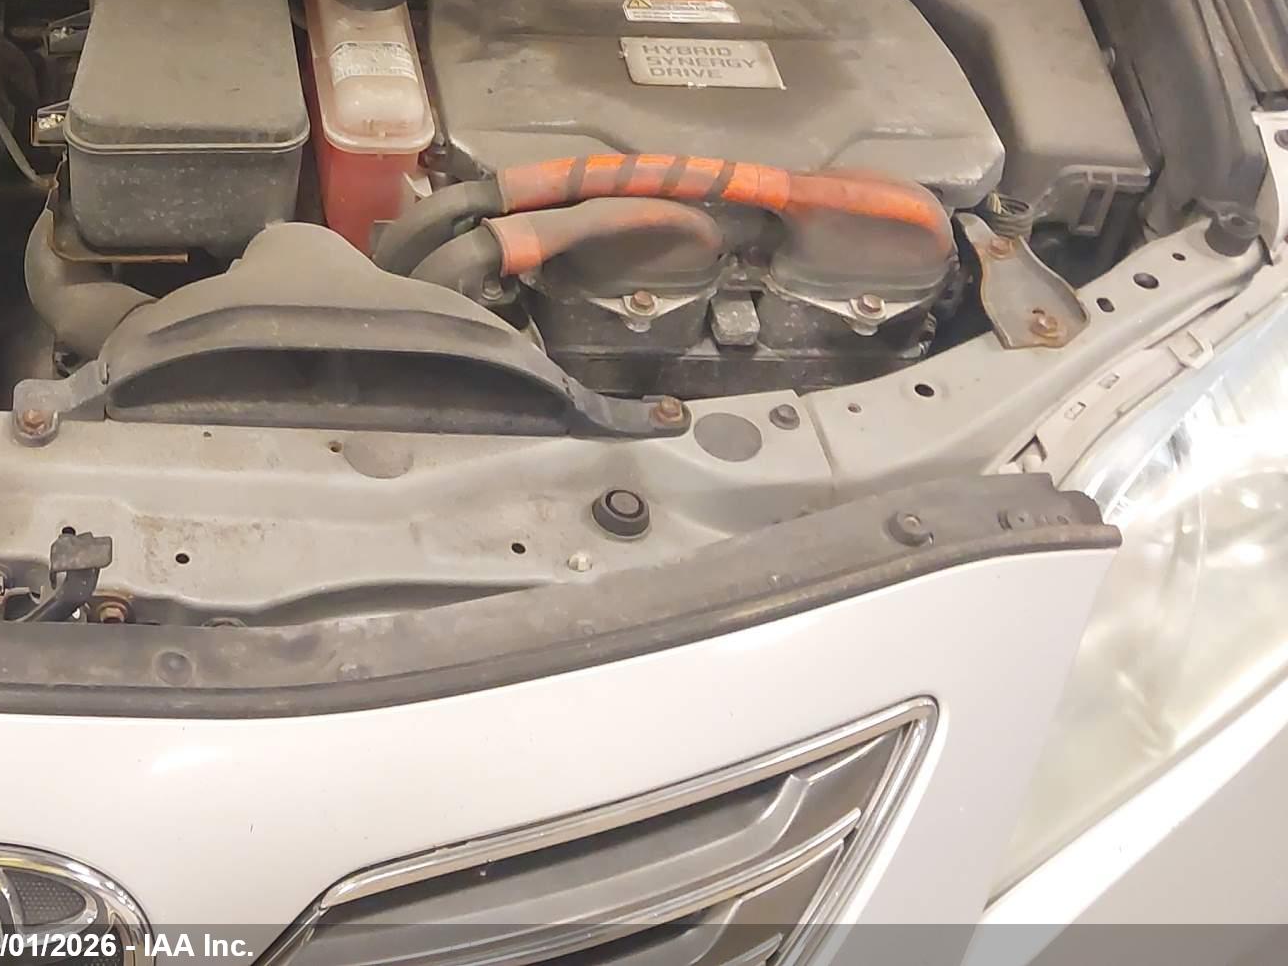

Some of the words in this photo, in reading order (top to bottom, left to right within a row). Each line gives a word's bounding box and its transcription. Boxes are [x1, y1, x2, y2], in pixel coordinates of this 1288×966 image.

[642, 44, 732, 57] HYBRID
[646, 55, 756, 69] SYNERGY
[650, 67, 724, 79] DRIVE
